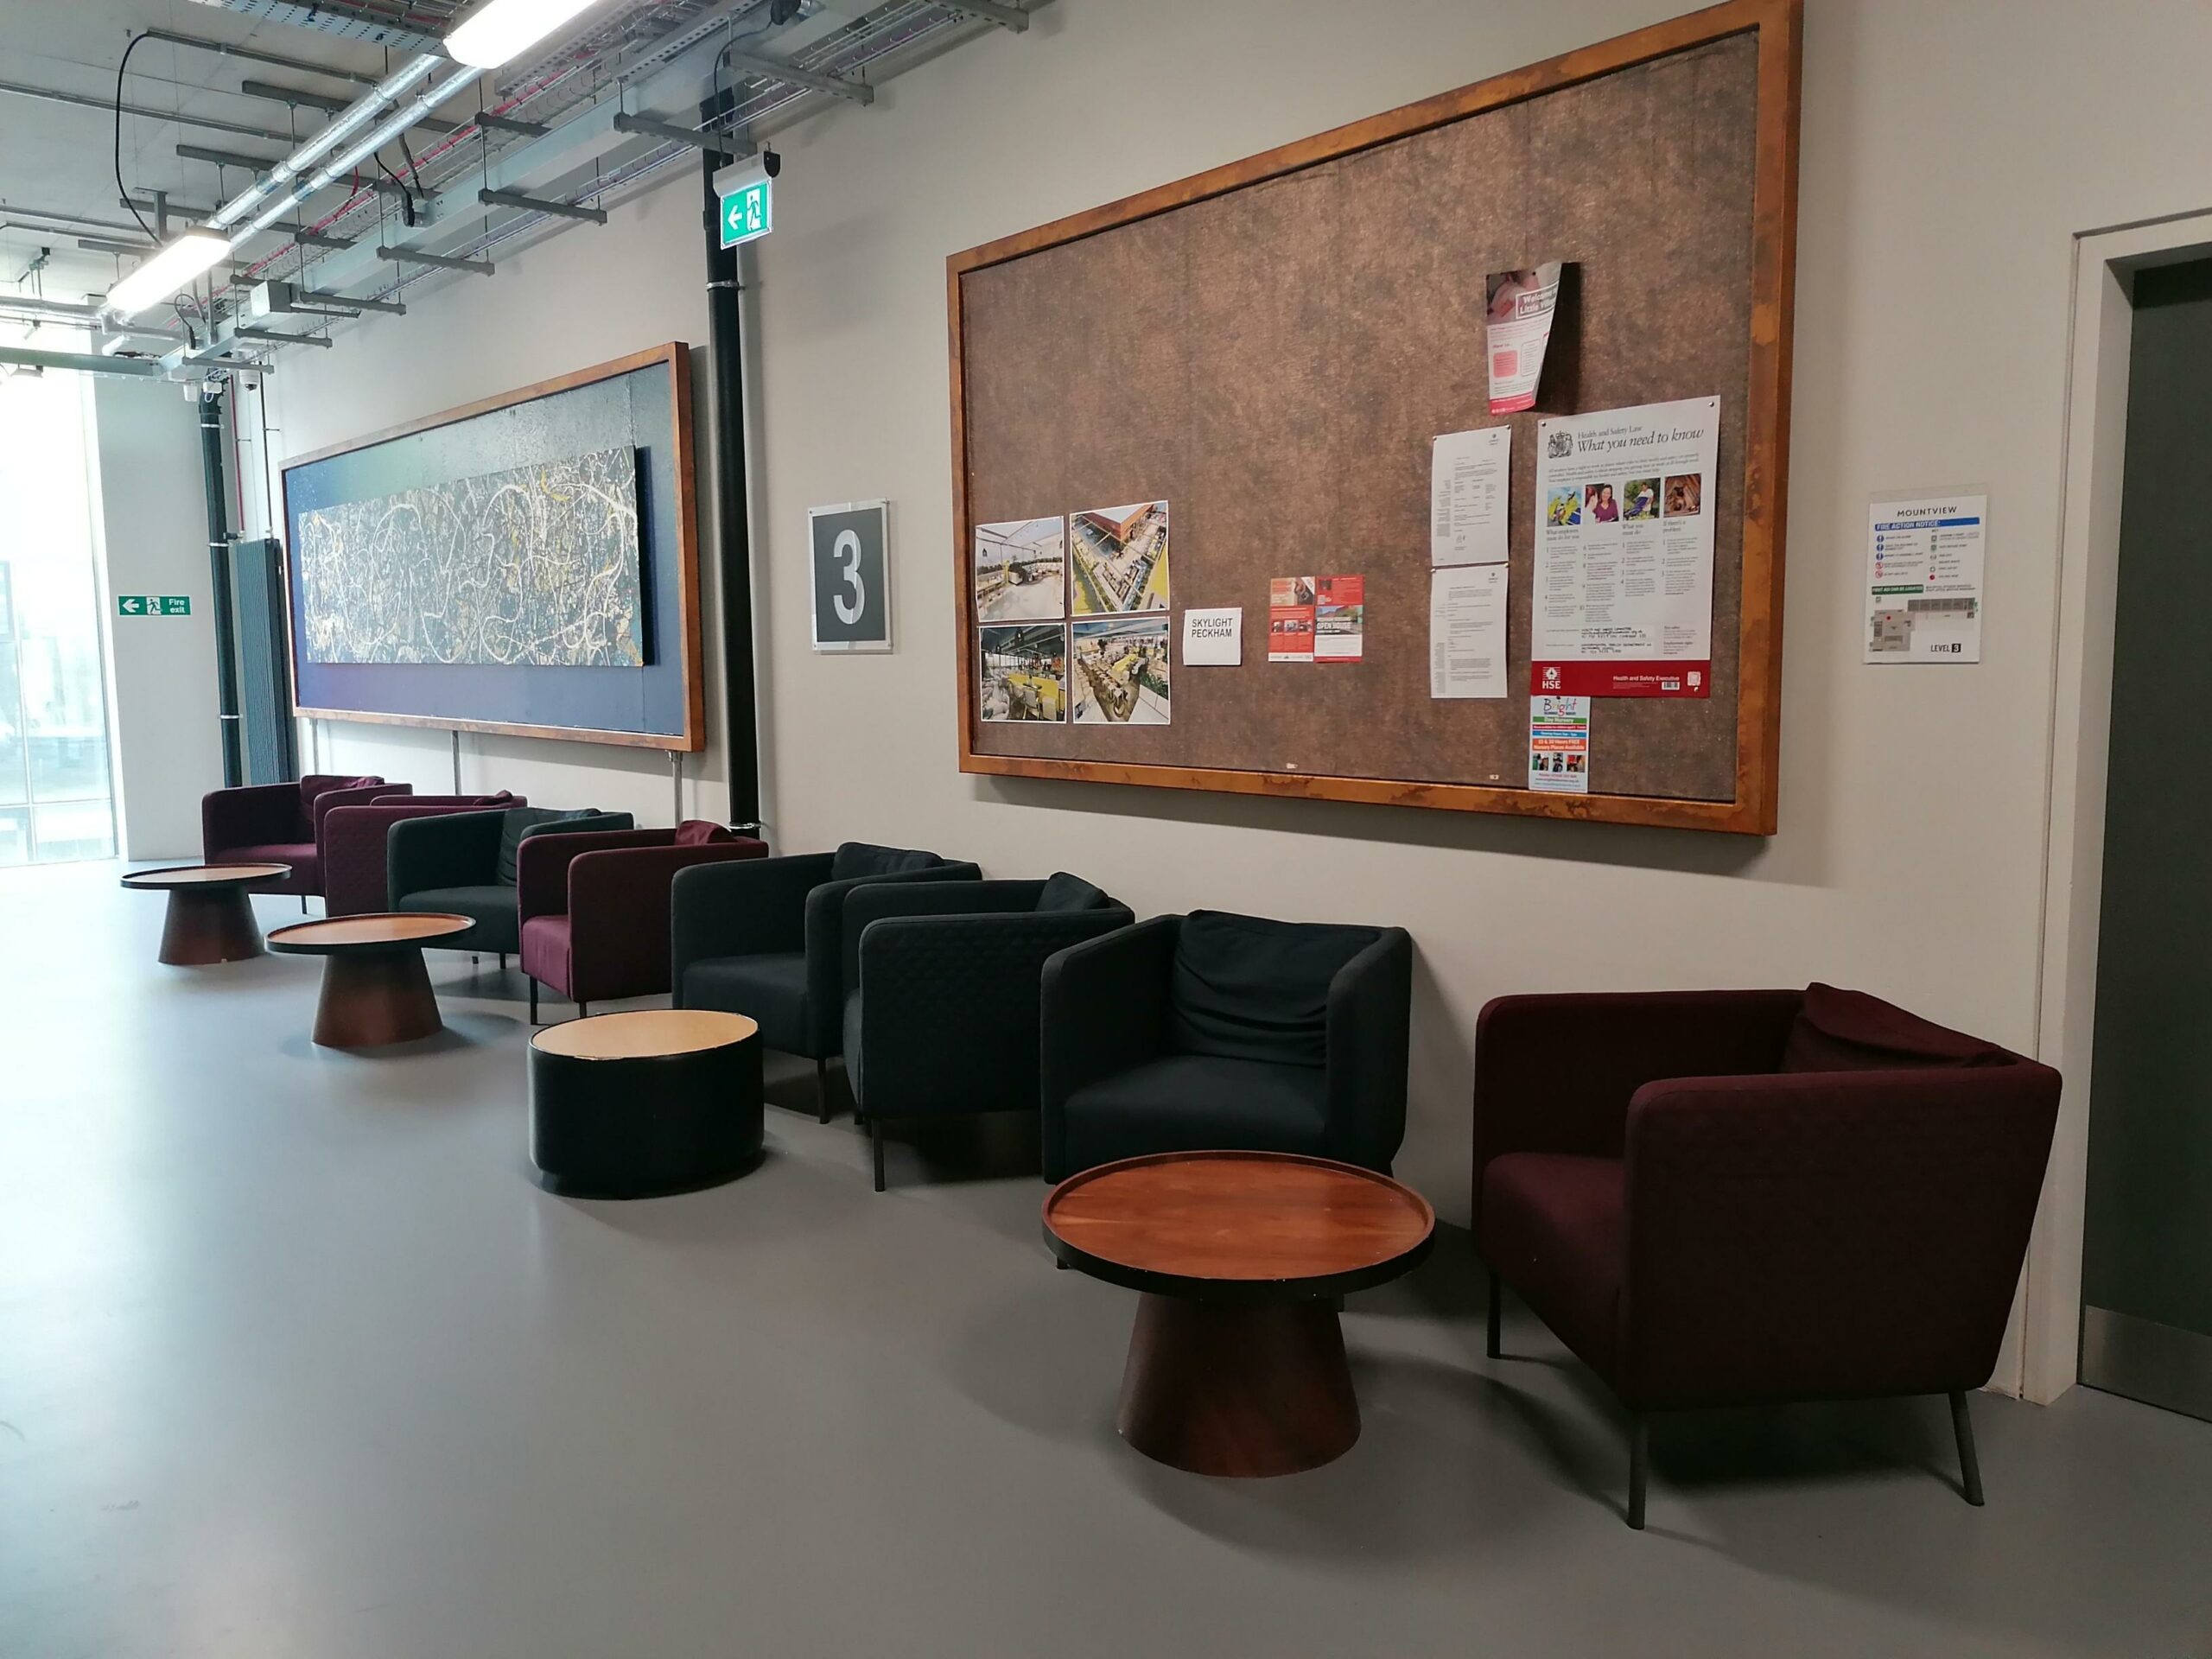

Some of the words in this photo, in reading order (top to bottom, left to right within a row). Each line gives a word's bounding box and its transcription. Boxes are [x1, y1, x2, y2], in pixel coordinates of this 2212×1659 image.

[1578, 430, 1597, 439] Health
[1578, 439, 1605, 453] What
[1607, 440, 1626, 453] you
[1630, 430, 1655, 447] need
[1657, 432, 1669, 443] to
[1671, 428, 1704, 442] know
[1897, 506, 1957, 517] MOUNTVIEW
[833, 529, 865, 625] 3
[1192, 618, 1232, 628] SKYLIGHT
[1192, 628, 1232, 638] PECKHAM
[1953, 644, 1960, 652] 3
[1542, 680, 1560, 690] HSE
[1543, 697, 1577, 716] Bright
